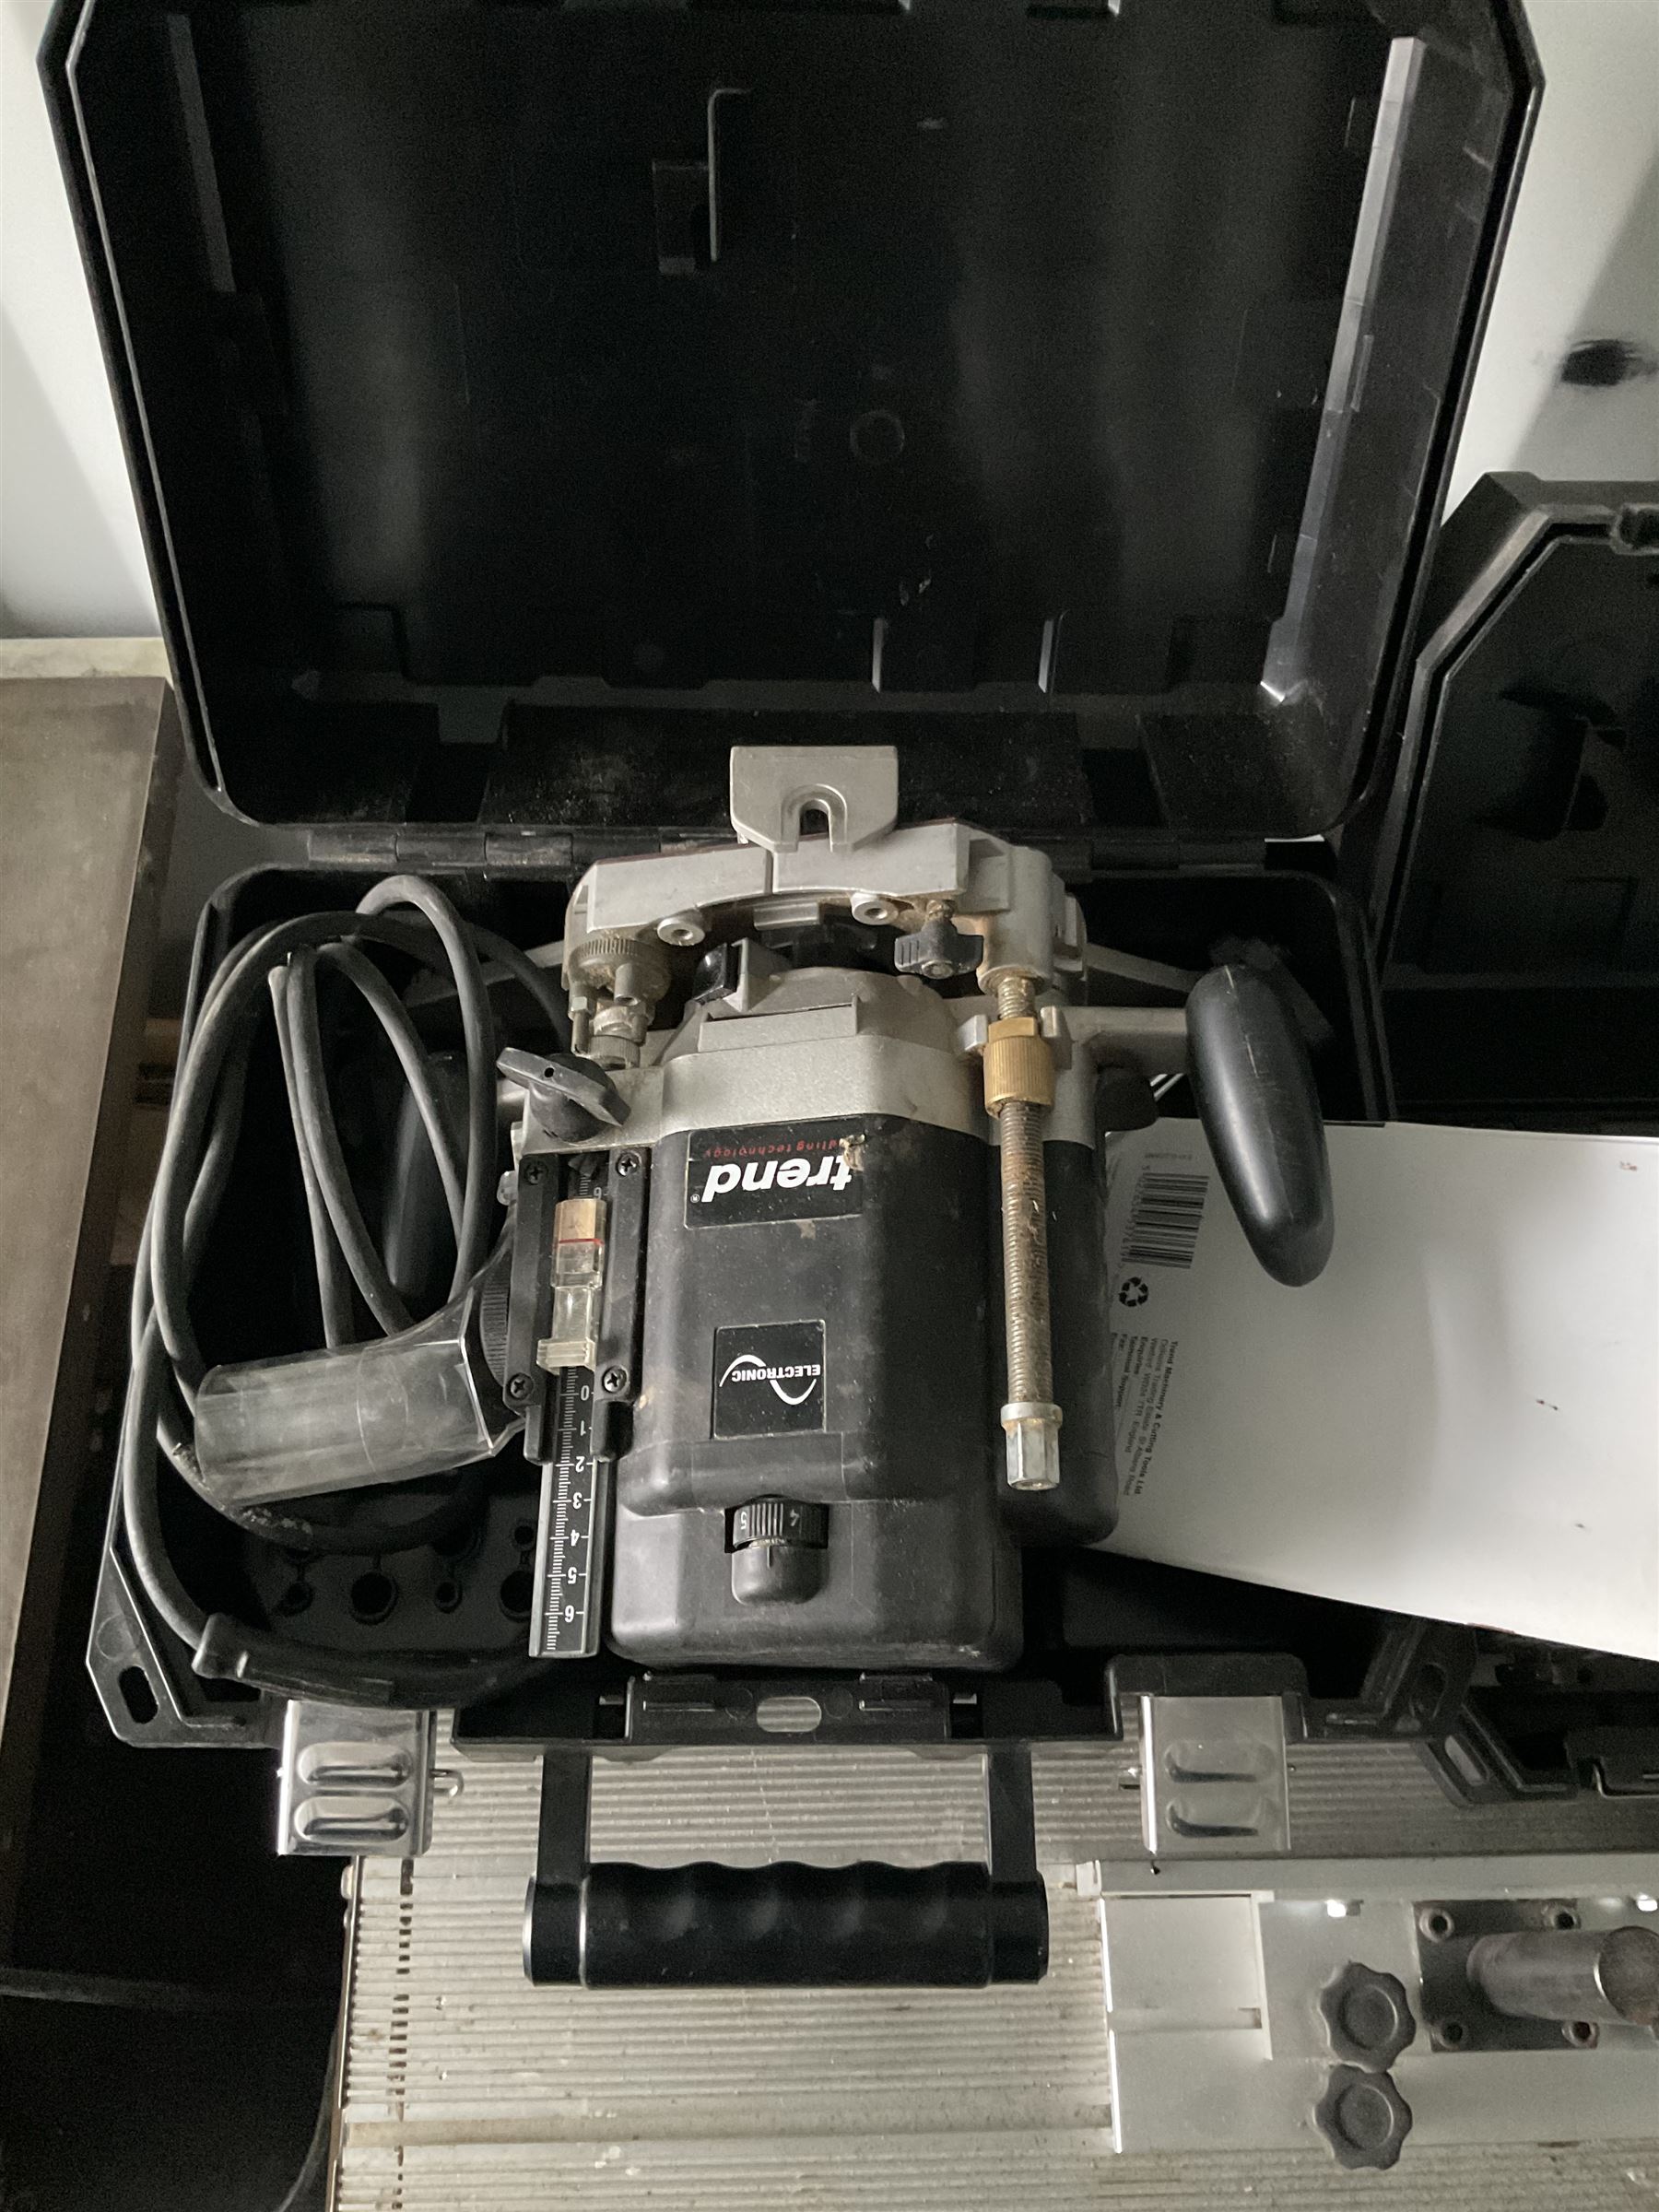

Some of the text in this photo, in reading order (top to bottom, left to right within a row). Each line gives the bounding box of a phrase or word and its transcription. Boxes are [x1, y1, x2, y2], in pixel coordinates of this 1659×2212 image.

[705, 1143, 792, 1159] technology
[701, 1155, 853, 1203] trend
[1167, 1340, 1179, 1364] Trend
[731, 1364, 821, 1382] ELECTRONIC
[580, 1385, 590, 1401] 0
[1156, 1366, 1173, 1410] Machinery
[580, 1420, 586, 1436] 1
[1145, 1422, 1161, 1453] Cutting
[575, 1456, 585, 1472] 2
[1139, 1456, 1152, 1477] Tools
[1134, 1480, 1145, 1494] Ltd
[572, 1492, 582, 1509] 3
[740, 1512, 747, 1530] 5
[789, 1509, 800, 1527] 4
[571, 1529, 580, 1547] 4
[567, 1567, 577, 1584] 5
[564, 1605, 575, 1622] 6
